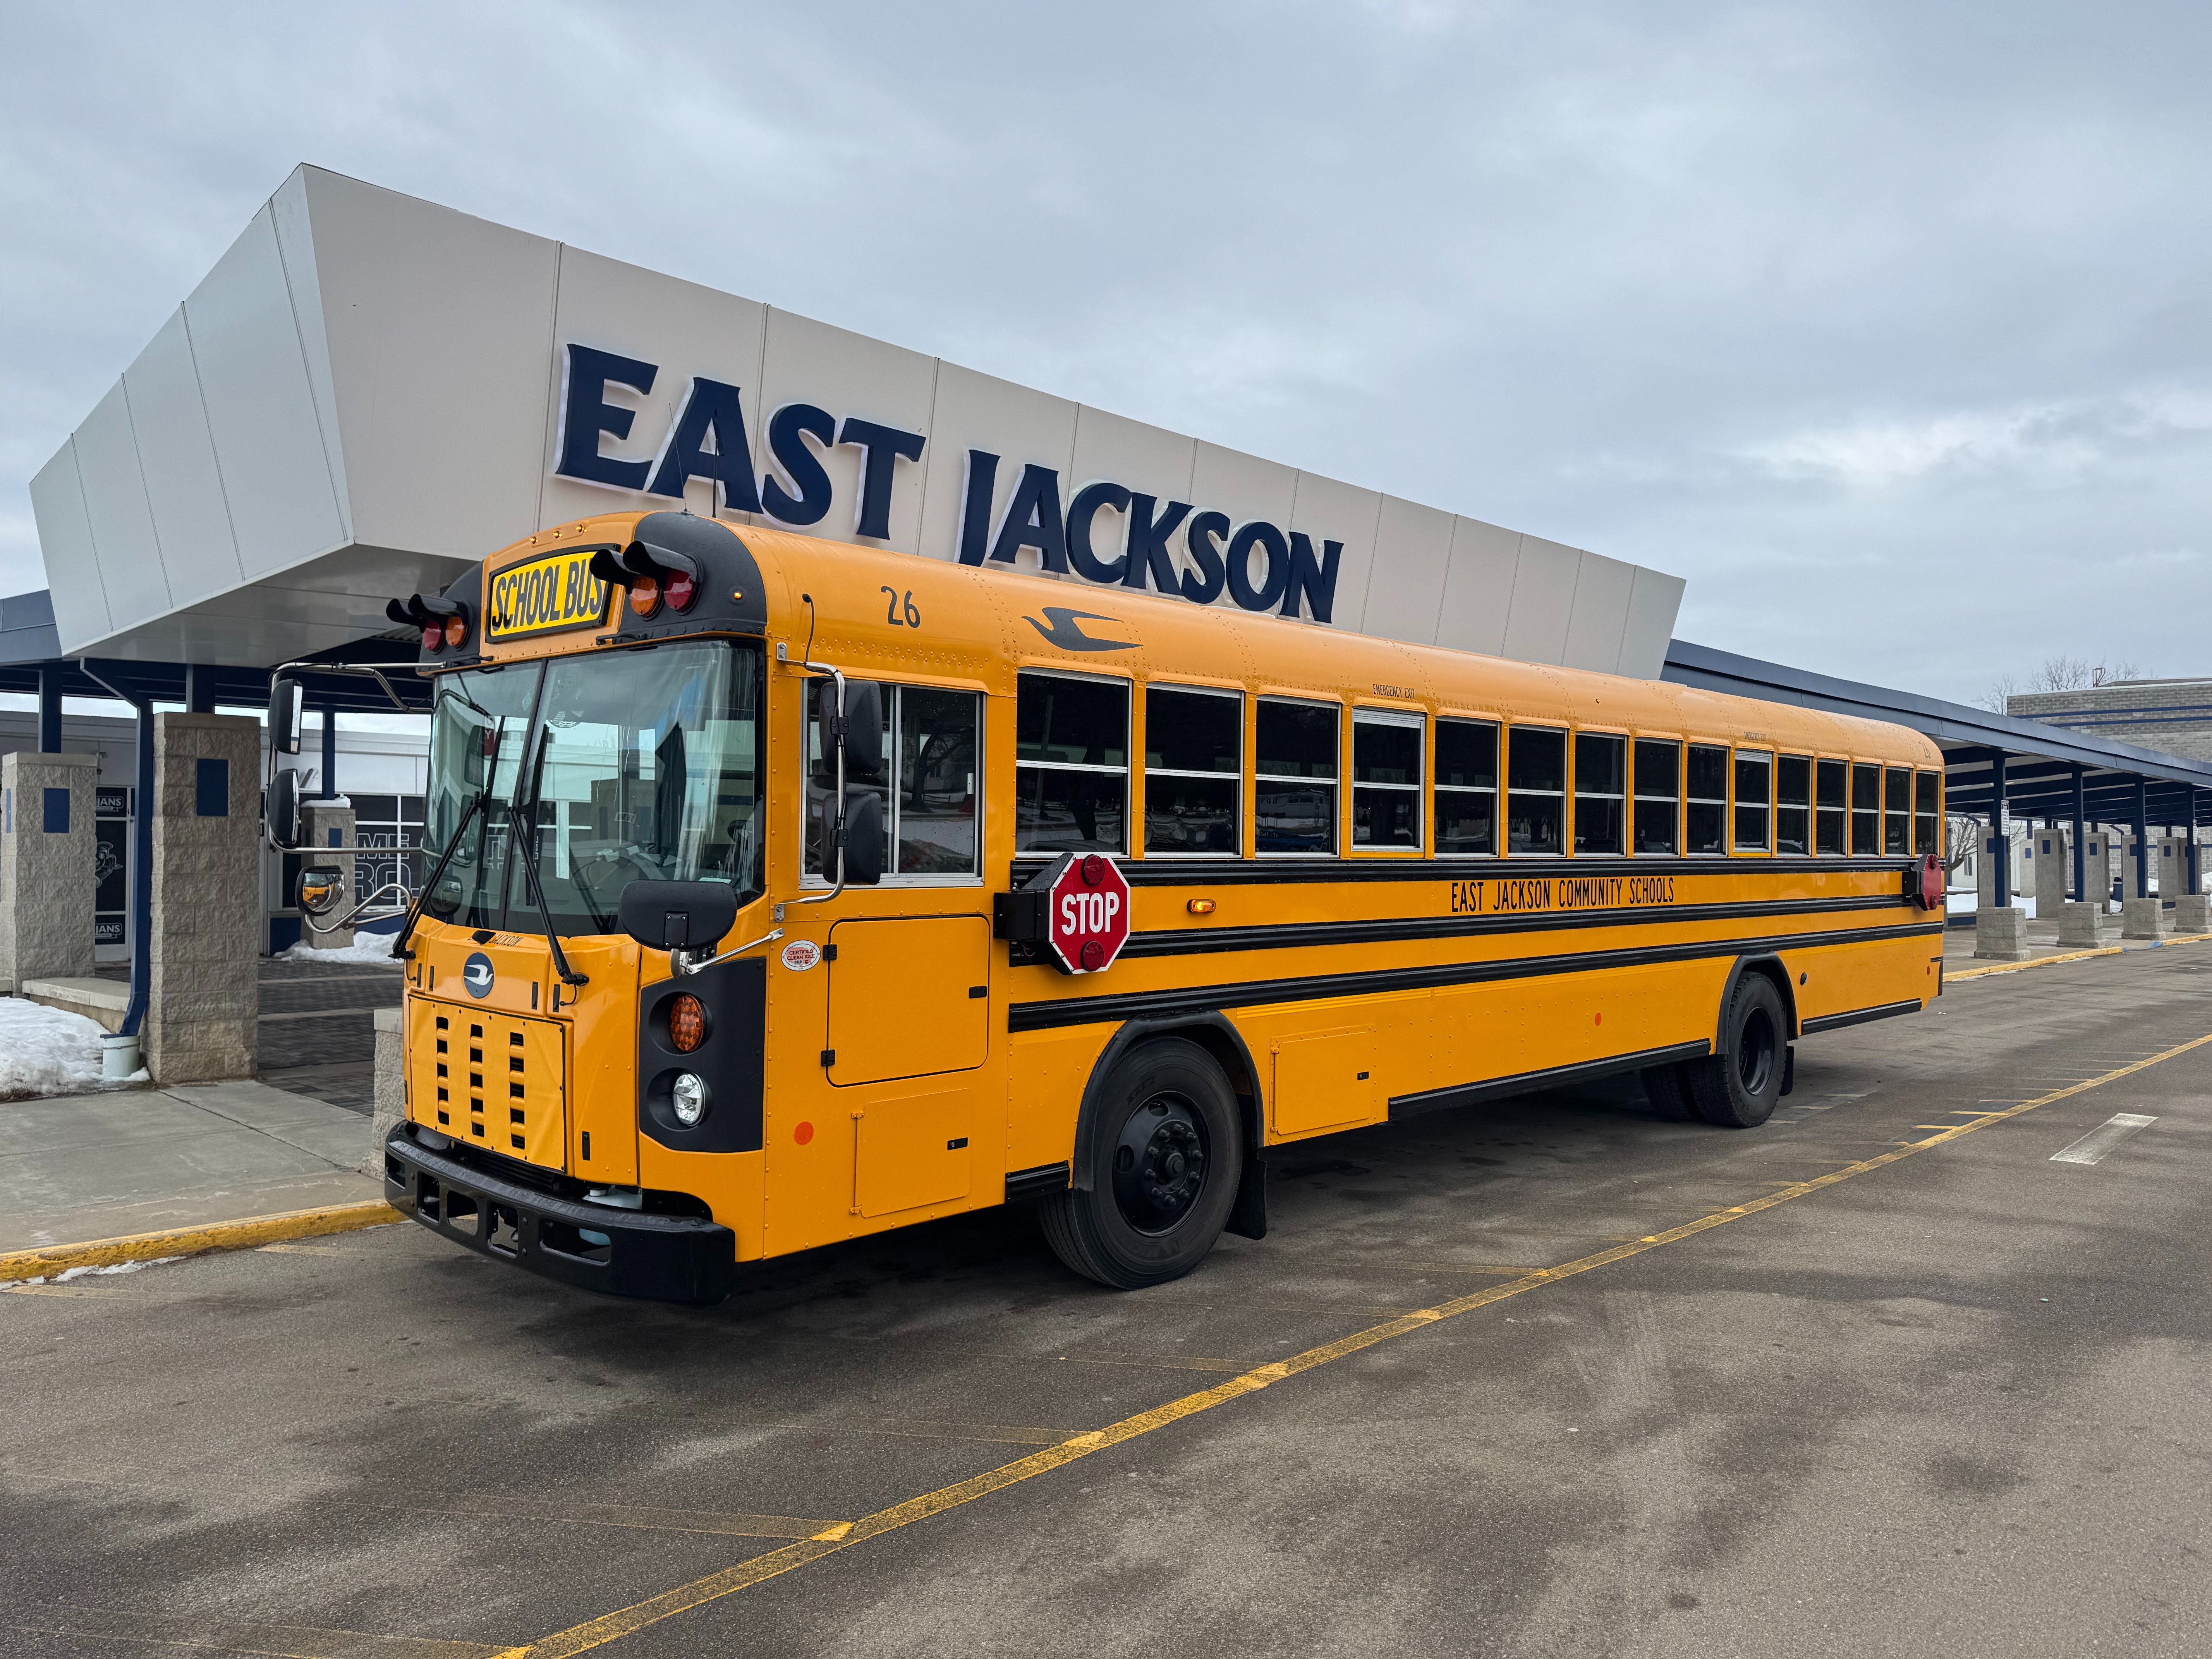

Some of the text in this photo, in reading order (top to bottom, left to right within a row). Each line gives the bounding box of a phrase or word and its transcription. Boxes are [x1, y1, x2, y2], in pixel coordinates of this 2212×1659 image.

[555, 344, 1344, 623] EAST JACKSON
[492, 558, 602, 631] SCHOOL BUS
[881, 586, 921, 628] 26
[1373, 684, 1415, 699] EMERGENCY EXIT
[1918, 742, 1931, 759] 26
[1061, 892, 1120, 935] STOP
[1452, 877, 1674, 912] EAST JACKSON COMMUNITY SCHOOLS
[489, 934, 524, 947] JACKSON
